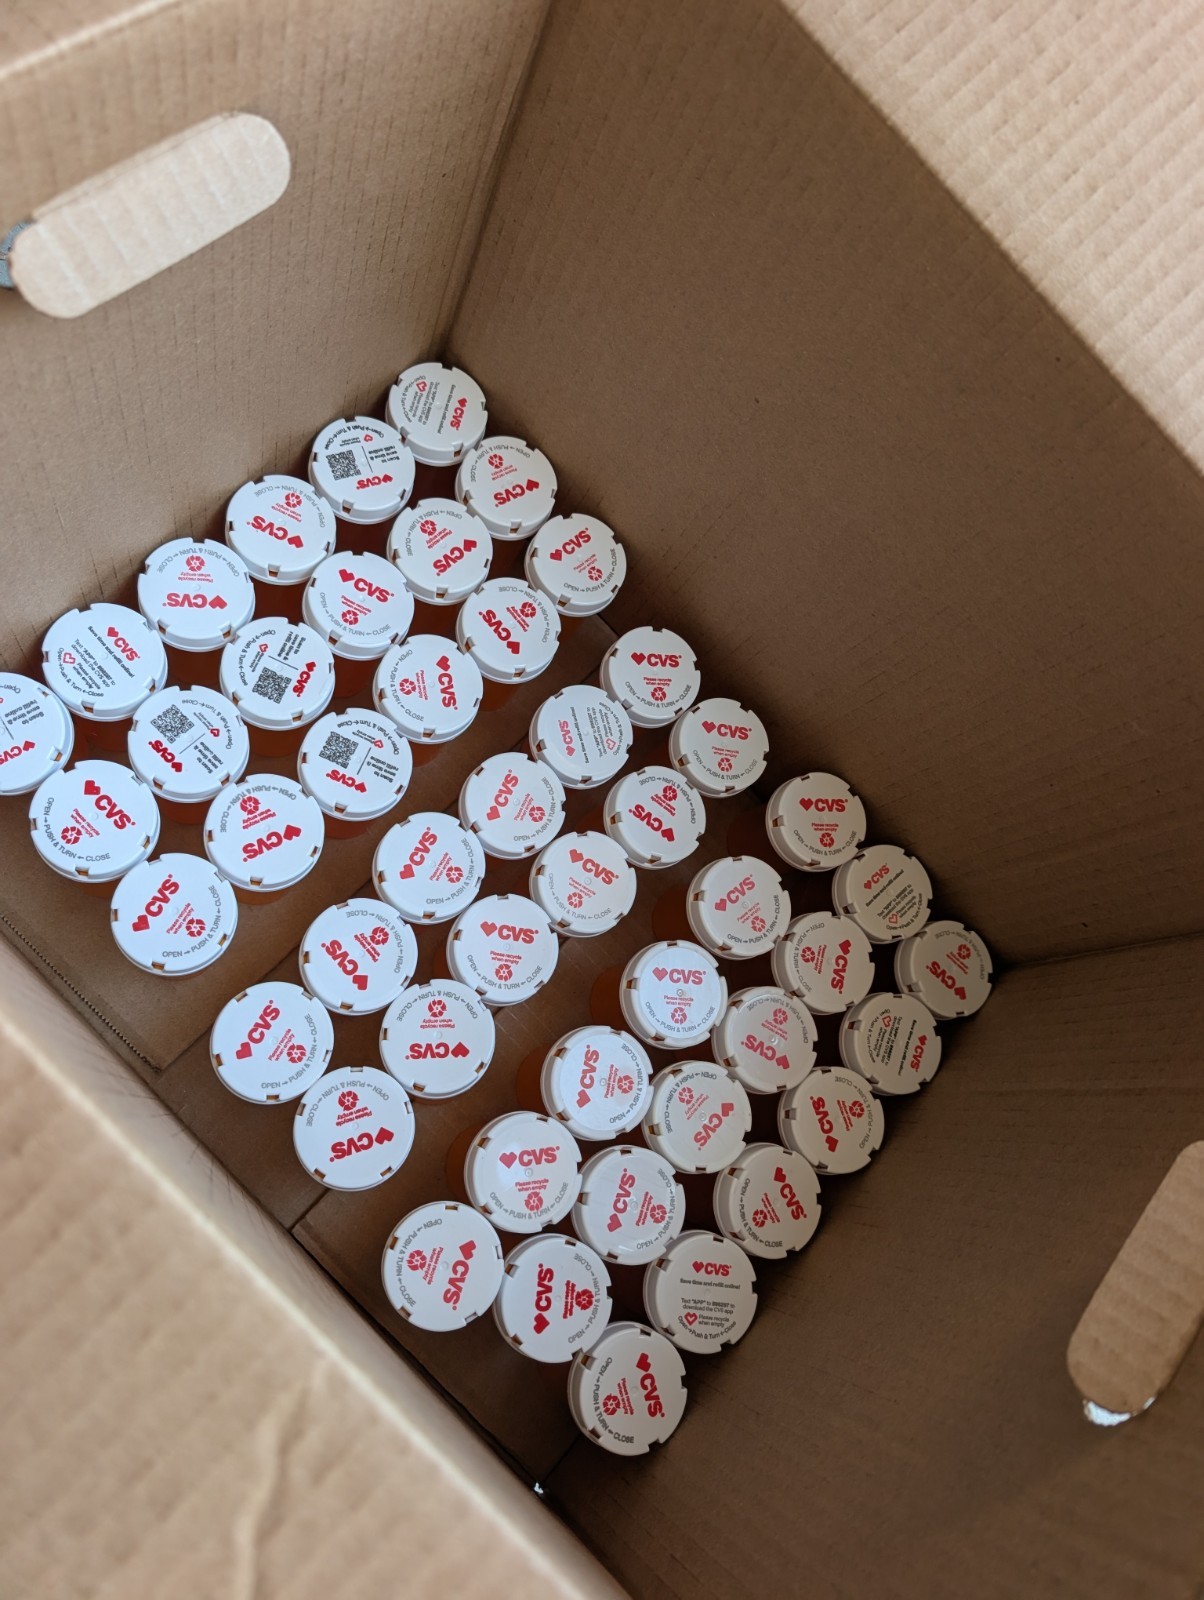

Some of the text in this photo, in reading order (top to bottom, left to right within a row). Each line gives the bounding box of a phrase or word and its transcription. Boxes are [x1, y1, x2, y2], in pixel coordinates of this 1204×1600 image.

[450, 407, 464, 429] CVS
[359, 476, 381, 489] CVS
[494, 484, 525, 504] CVS
[251, 516, 288, 540] CVS
[179, 548, 197, 556] TURN
[562, 532, 591, 554] CVS
[157, 556, 174, 574] CLOSE
[203, 550, 222, 561] PUSH
[433, 547, 464, 572] CVS
[227, 561, 240, 577] OPEN
[167, 593, 208, 608] CVS
[354, 578, 389, 602] CVS
[482, 610, 510, 641] CVS
[114, 637, 138, 661] CVS
[647, 653, 679, 667] CVS
[293, 671, 310, 696] CVS
[438, 673, 456, 707] CVS
[559, 721, 573, 744] CVS
[717, 724, 749, 739] CVS
[151, 740, 175, 762] CVS
[330, 769, 355, 787] CVS
[494, 774, 518, 807] CVS
[44, 797, 54, 816] OPEN
[95, 795, 131, 829] CVS
[814, 799, 846, 812] CVS
[633, 804, 662, 831] CVS
[44, 824, 55, 842] PUSH
[58, 844, 77, 858] TURN
[242, 832, 283, 859] CVS
[409, 830, 437, 866] CVS
[85, 853, 111, 862] CLOSE
[582, 859, 615, 885] CVS
[871, 865, 890, 884] CVS
[145, 879, 179, 916] CVS
[208, 885, 222, 907] CLOSE
[726, 877, 755, 904] CVS
[210, 915, 220, 932] TURN
[498, 925, 535, 944] CVS
[727, 933, 743, 944] OPEN
[748, 935, 763, 945] PUSH
[766, 920, 777, 935] TURN
[162, 950, 183, 958] OPEN
[190, 940, 208, 952] PUSH
[326, 940, 359, 975] CVS
[467, 954, 478, 971] OPEN
[481, 975, 498, 988] PUSH
[503, 981, 520, 989] TURN
[526, 965, 543, 983] CLOSE
[669, 969, 703, 985] CVS
[831, 954, 848, 993] CVS
[929, 961, 956, 989] CVS
[247, 1005, 280, 1044] CVS
[304, 1014, 317, 1035] CLOSE
[307, 1047, 317, 1064] TURN
[410, 1043, 449, 1059] CVS
[745, 1035, 776, 1060] CVS
[910, 1045, 924, 1072] CVS
[288, 1071, 305, 1084] PUSH
[580, 1050, 599, 1089] CVS
[812, 1097, 833, 1134] CVS
[693, 1113, 722, 1147] CVS
[331, 1132, 374, 1159] CVS
[519, 1147, 557, 1166] CVS
[613, 1174, 635, 1214] CVS
[780, 1184, 804, 1219] CVS
[705, 1263, 730, 1276] CVS
[443, 1260, 469, 1305] CVS
[535, 1267, 554, 1311] CVS
[599, 1357, 613, 1374] OPEN
[640, 1374, 663, 1417] CVS
[597, 1413, 609, 1430] TURN
[613, 1433, 635, 1443] CLOSE
